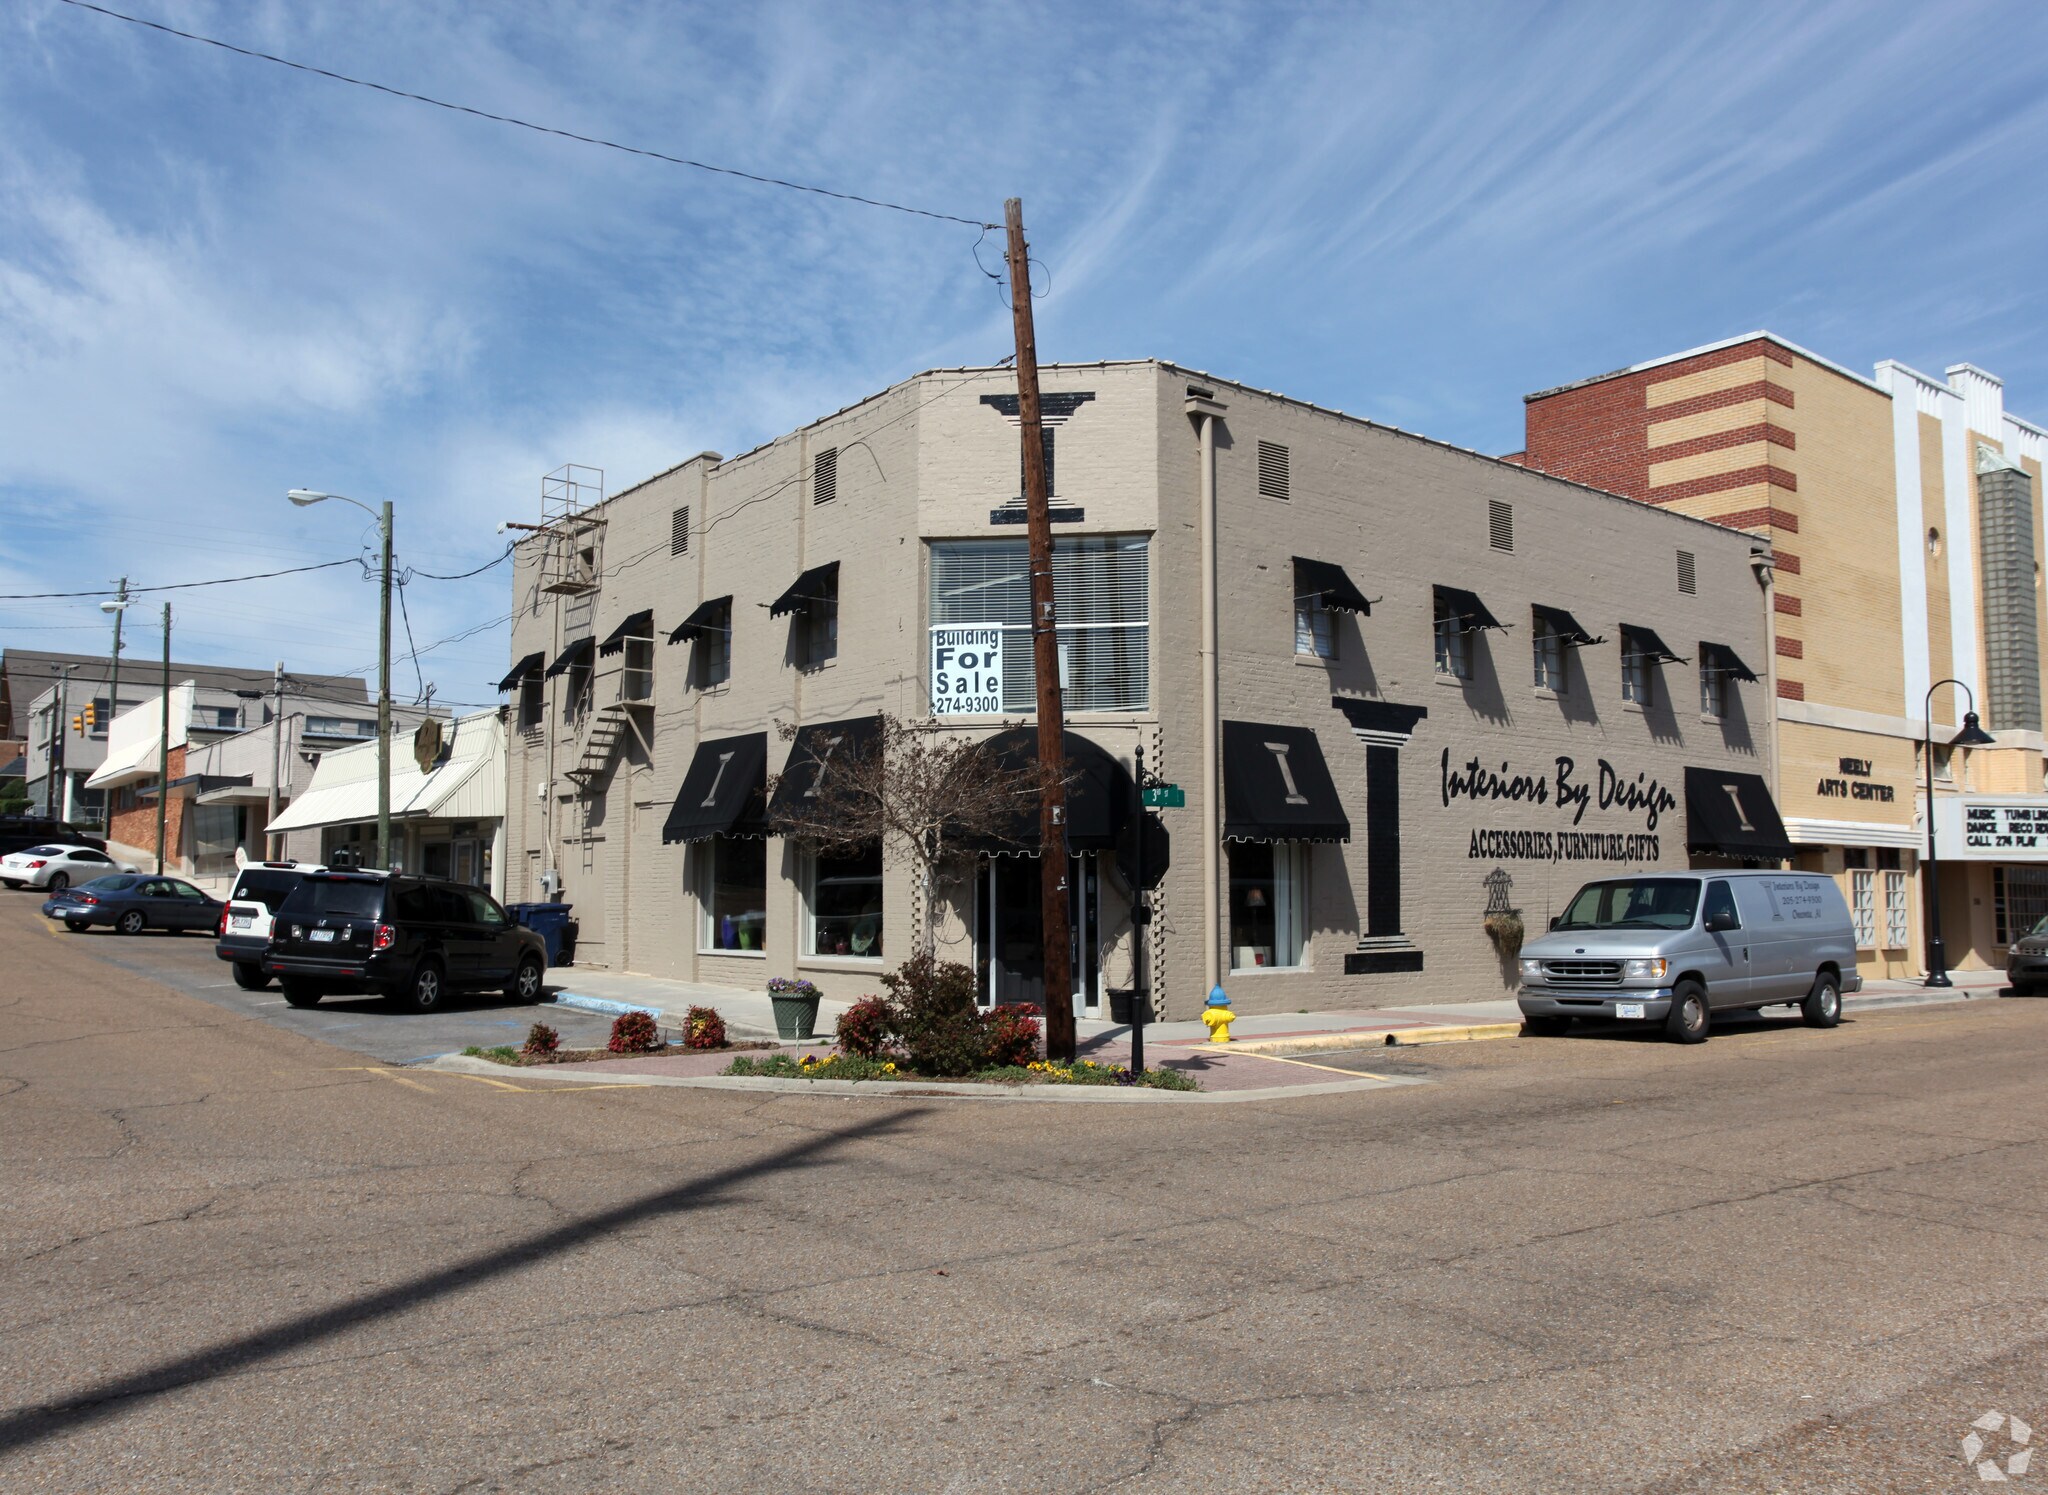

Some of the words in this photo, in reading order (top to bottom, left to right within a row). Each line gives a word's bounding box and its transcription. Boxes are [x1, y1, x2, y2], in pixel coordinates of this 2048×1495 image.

[936, 630, 999, 649] Building
[936, 647, 999, 670] For
[936, 671, 999, 695] Sale
[936, 696, 999, 713] 274-9300
[1838, 757, 1873, 777] NEELY
[1441, 747, 1548, 807] Interiors
[1555, 756, 1591, 826] By
[1598, 758, 1676, 831] Design
[1817, 778, 1848, 798] ARTS
[1851, 781, 1895, 802] CENTER
[1967, 809, 1996, 820] MUSIC
[1966, 822, 1998, 834] DANCE
[1966, 835, 1992, 847] CALL
[1995, 836, 2013, 848] 274
[2015, 836, 2038, 848] PLAY
